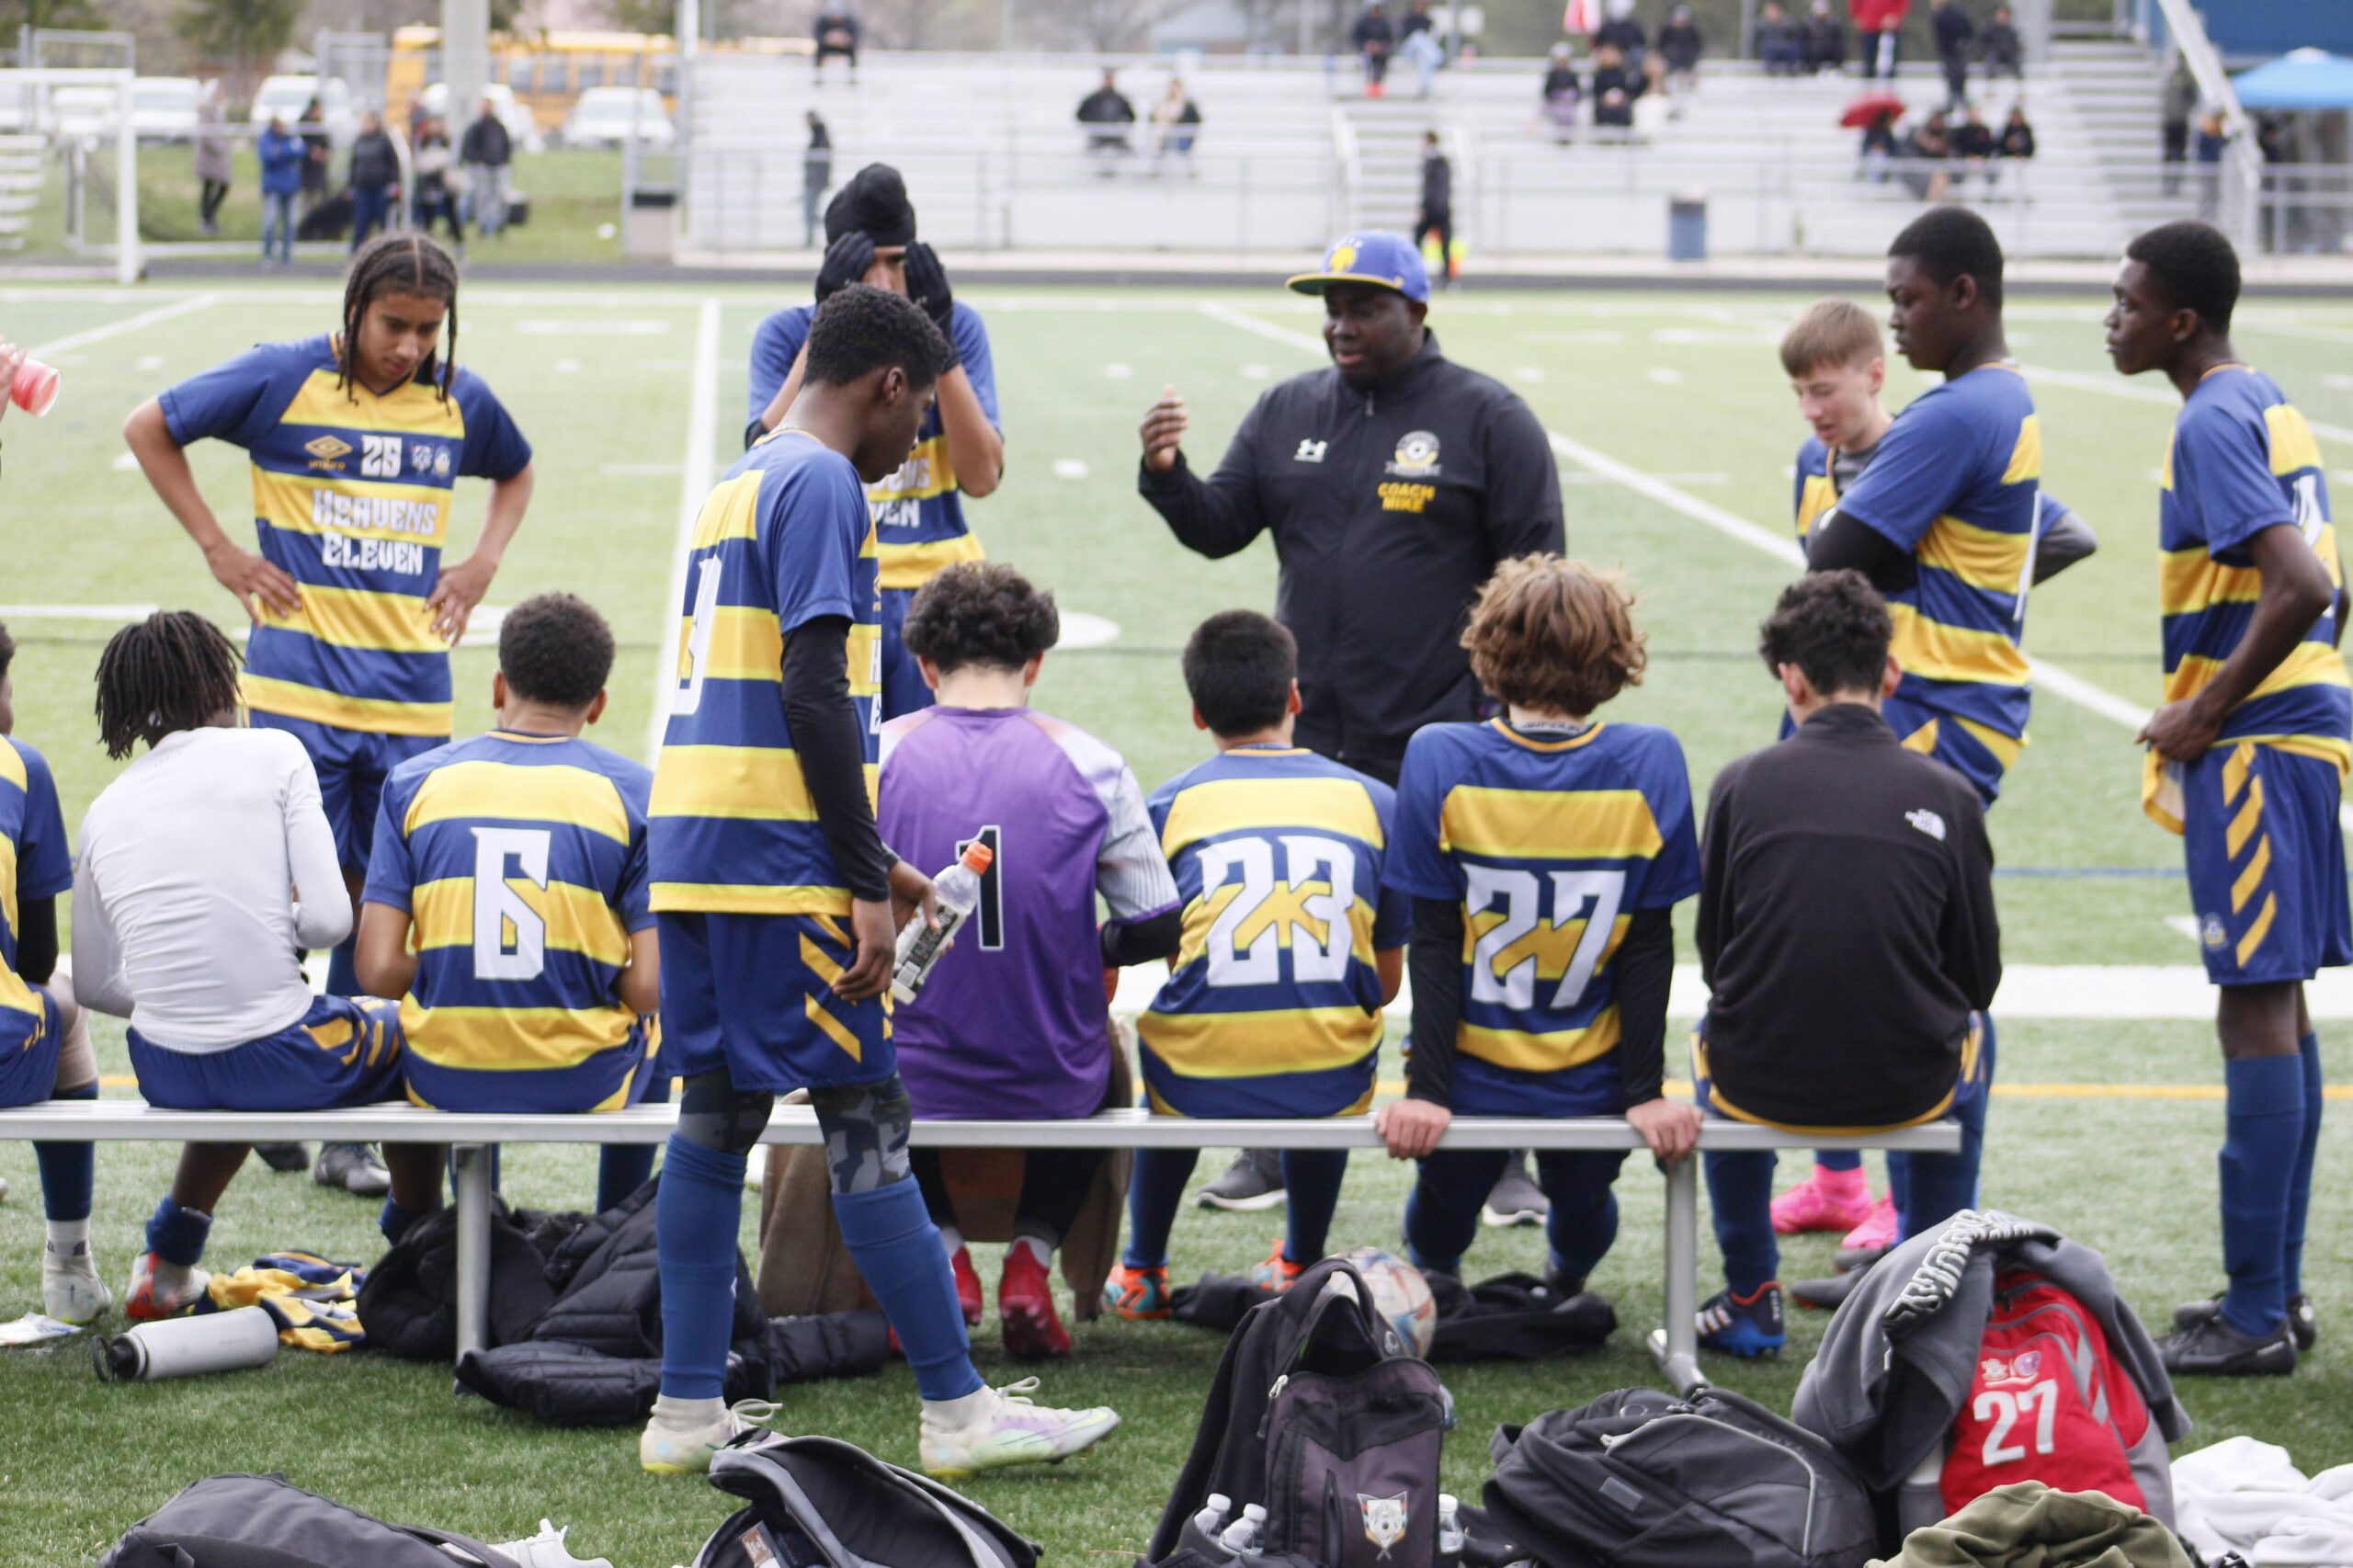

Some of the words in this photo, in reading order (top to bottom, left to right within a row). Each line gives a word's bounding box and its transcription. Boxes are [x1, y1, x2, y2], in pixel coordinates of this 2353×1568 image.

[361, 435, 403, 478] 25
[312, 488, 438, 536] HEAVENS
[323, 530, 424, 575] ELEVEN
[470, 826, 551, 981] 6
[955, 824, 1005, 951] 1
[1195, 835, 1356, 987] 23
[1460, 861, 1627, 1010] 27
[1972, 1378, 2058, 1467] 27
